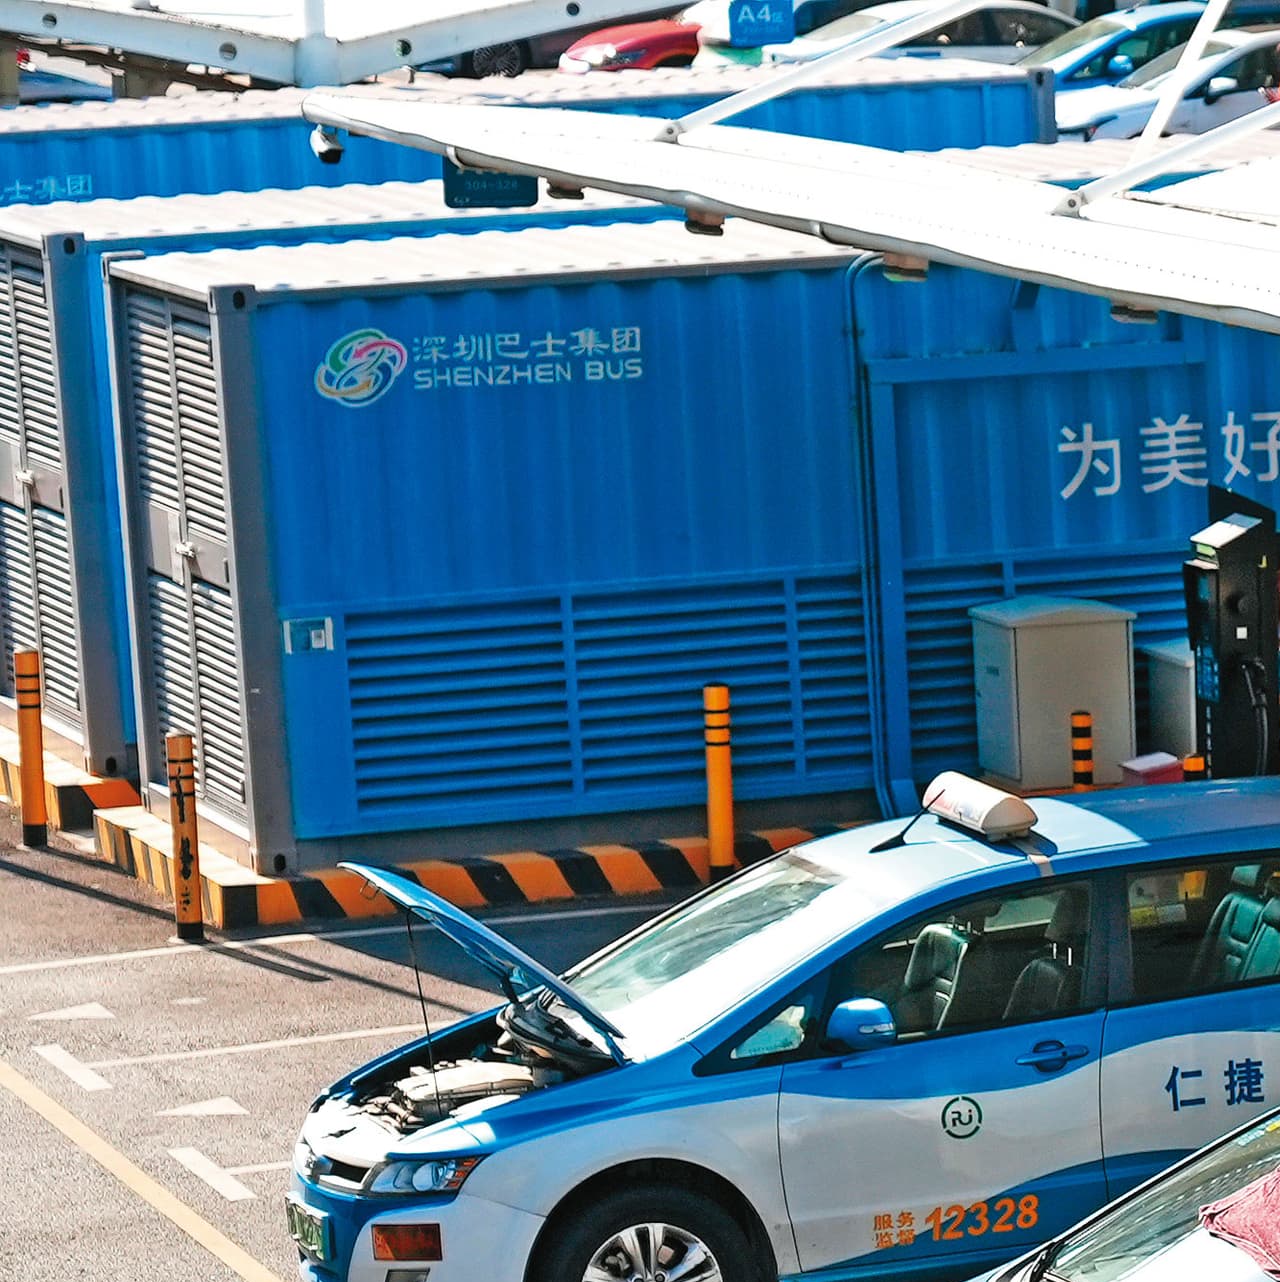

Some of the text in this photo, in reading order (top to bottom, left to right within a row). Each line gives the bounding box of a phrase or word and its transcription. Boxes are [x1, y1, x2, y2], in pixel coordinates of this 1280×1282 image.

[413, 326, 642, 364] 深圳巴士集团
[413, 358, 643, 389] SHENZHEN BUS
[1165, 1058, 1264, 1112] 仁捷
[873, 1211, 916, 1231] 服务
[925, 1194, 1038, 1241] 12328
